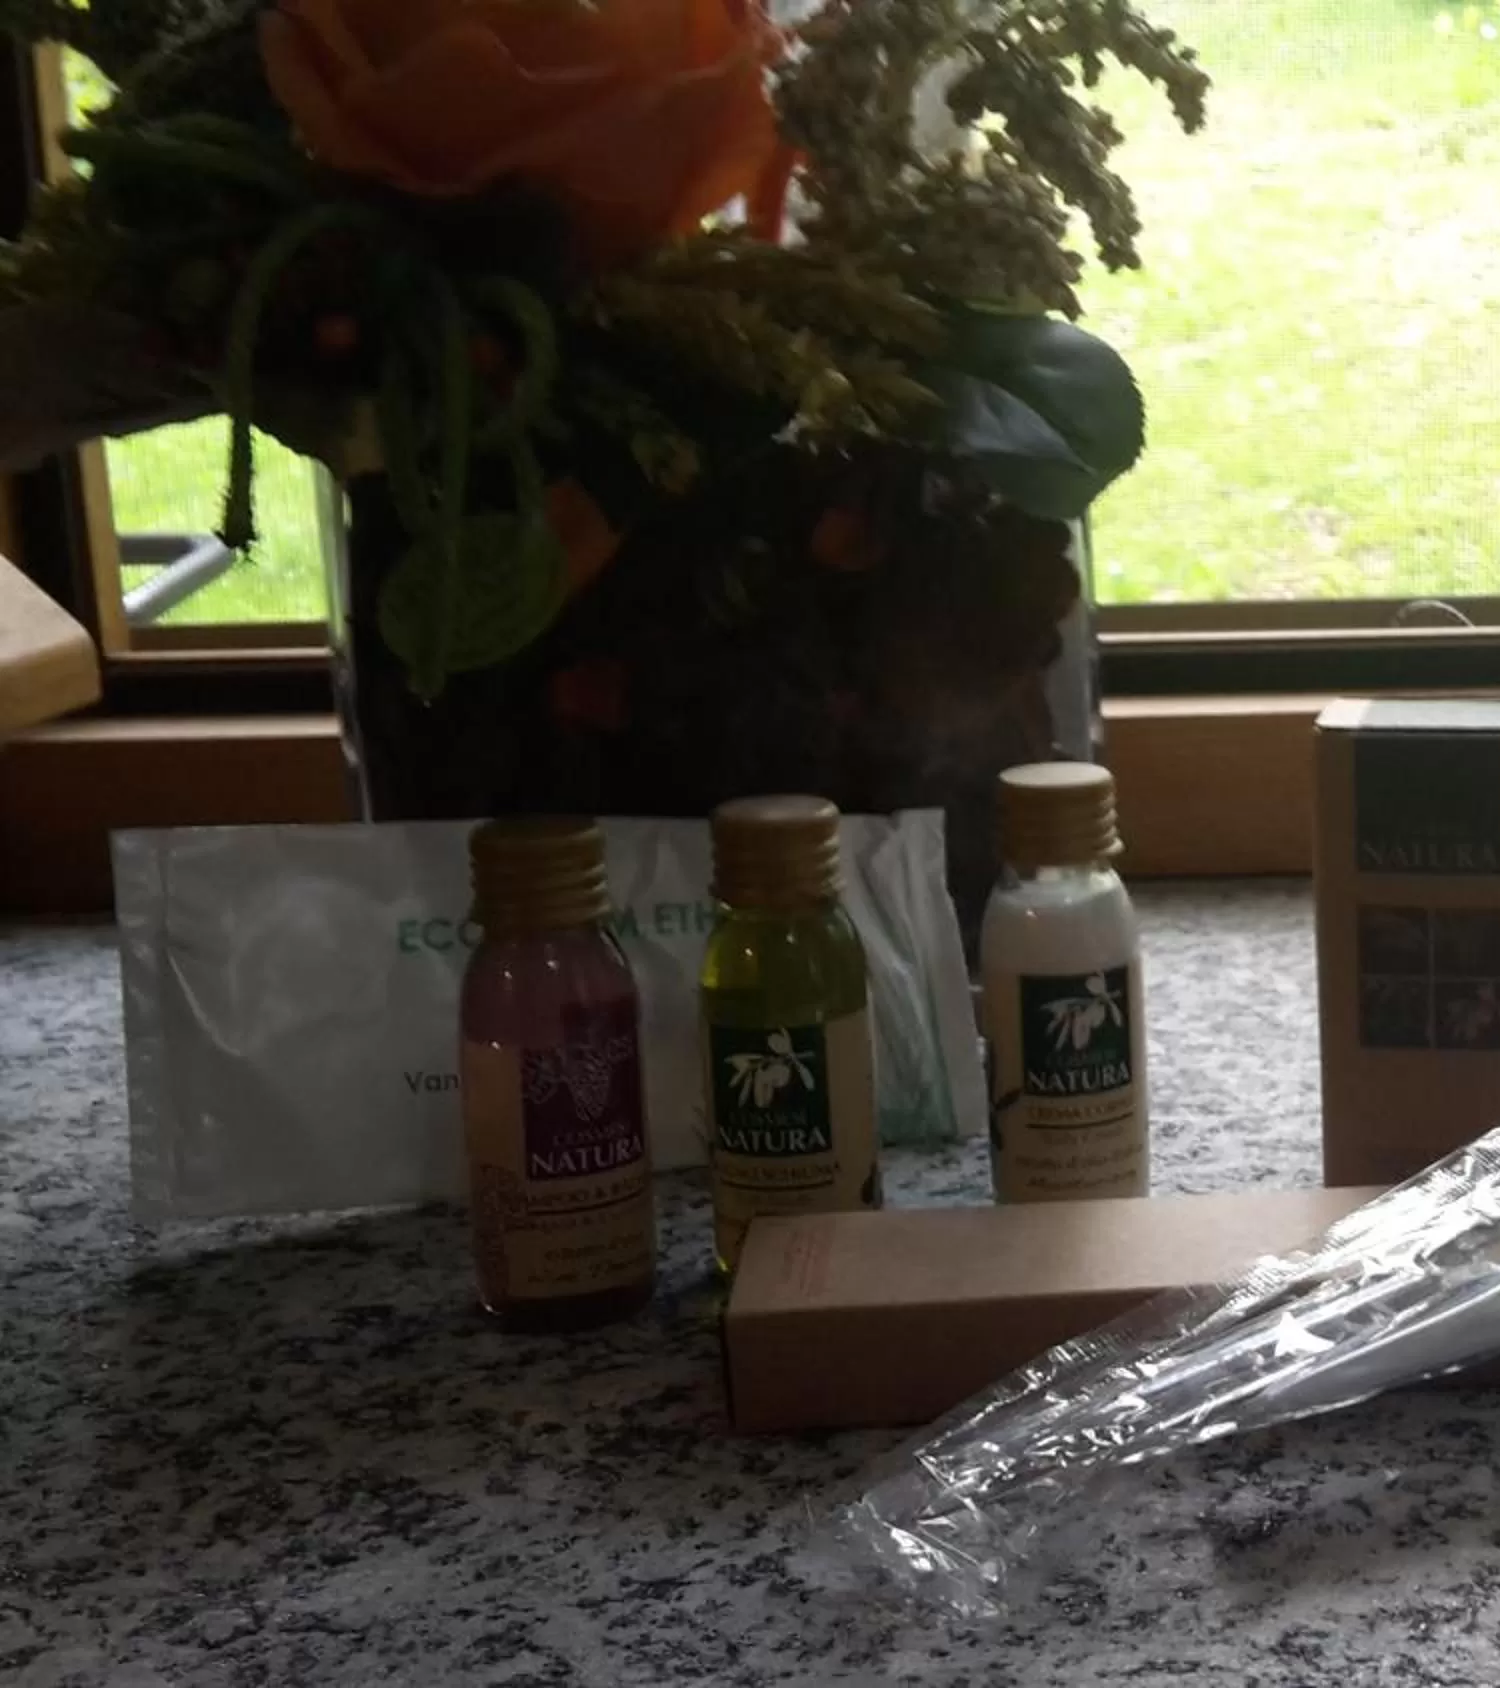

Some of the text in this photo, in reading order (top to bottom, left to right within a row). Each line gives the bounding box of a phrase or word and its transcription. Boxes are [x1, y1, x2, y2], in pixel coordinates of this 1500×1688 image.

[1028, 1061, 1130, 1094] NATURA
[530, 1134, 643, 1176] NATURA
[716, 1124, 829, 1153] NATURA
